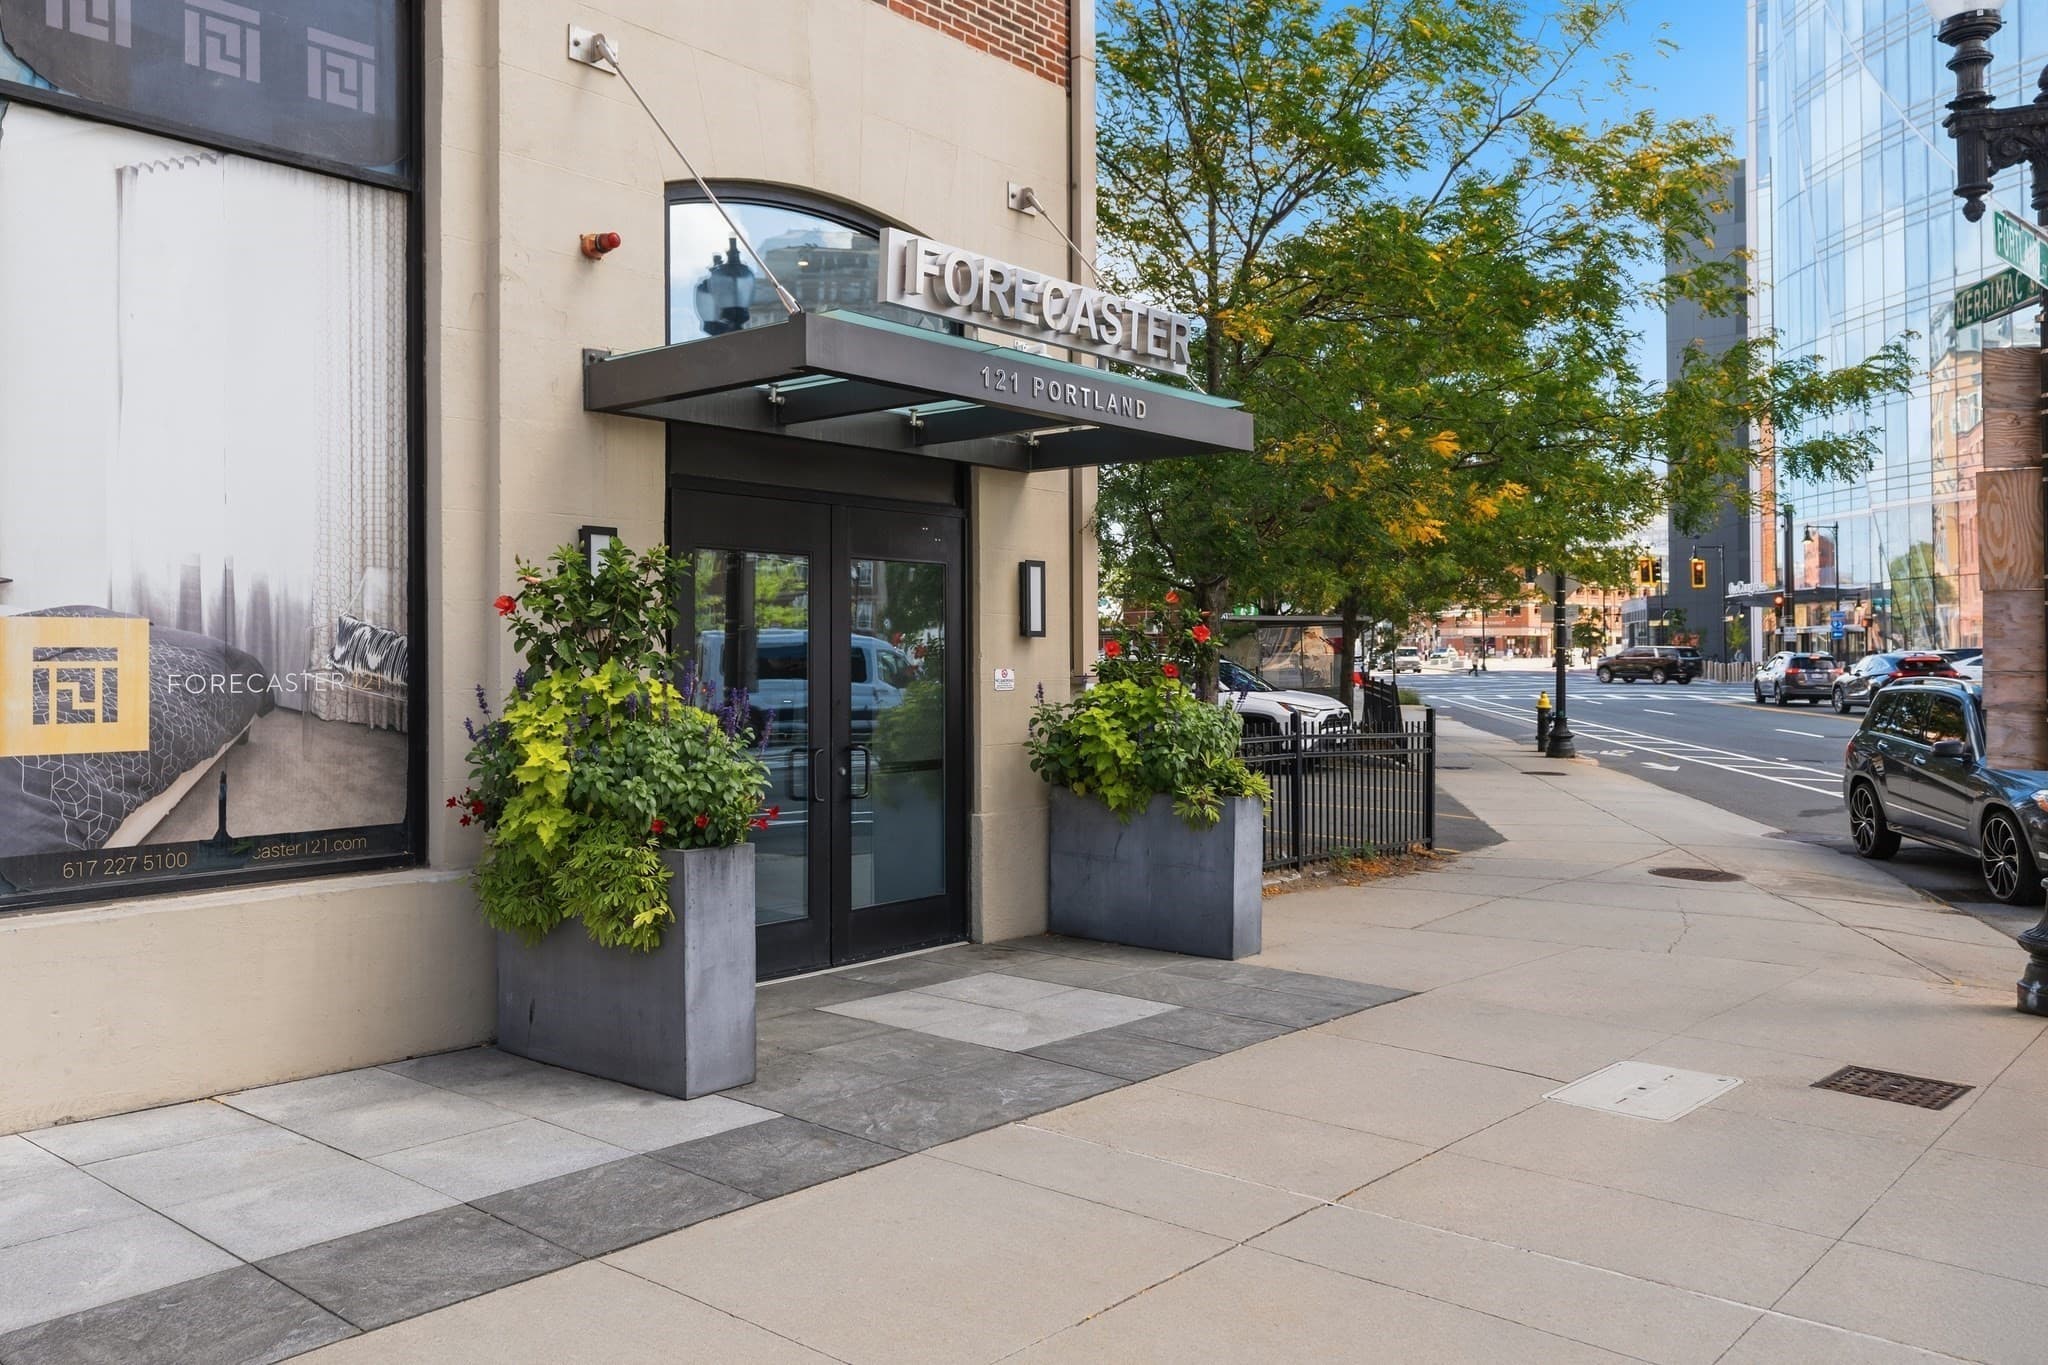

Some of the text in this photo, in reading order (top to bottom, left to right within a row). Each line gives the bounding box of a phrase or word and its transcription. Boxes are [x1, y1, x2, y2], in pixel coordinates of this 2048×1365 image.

[904, 238, 1192, 365] FORECASTER
[1956, 272, 2022, 326] MERRIMAC
[981, 366, 1147, 419] 121 PORTLAND
[168, 672, 383, 694] FORECASTER 121
[63, 852, 188, 879] 617 227 5100
